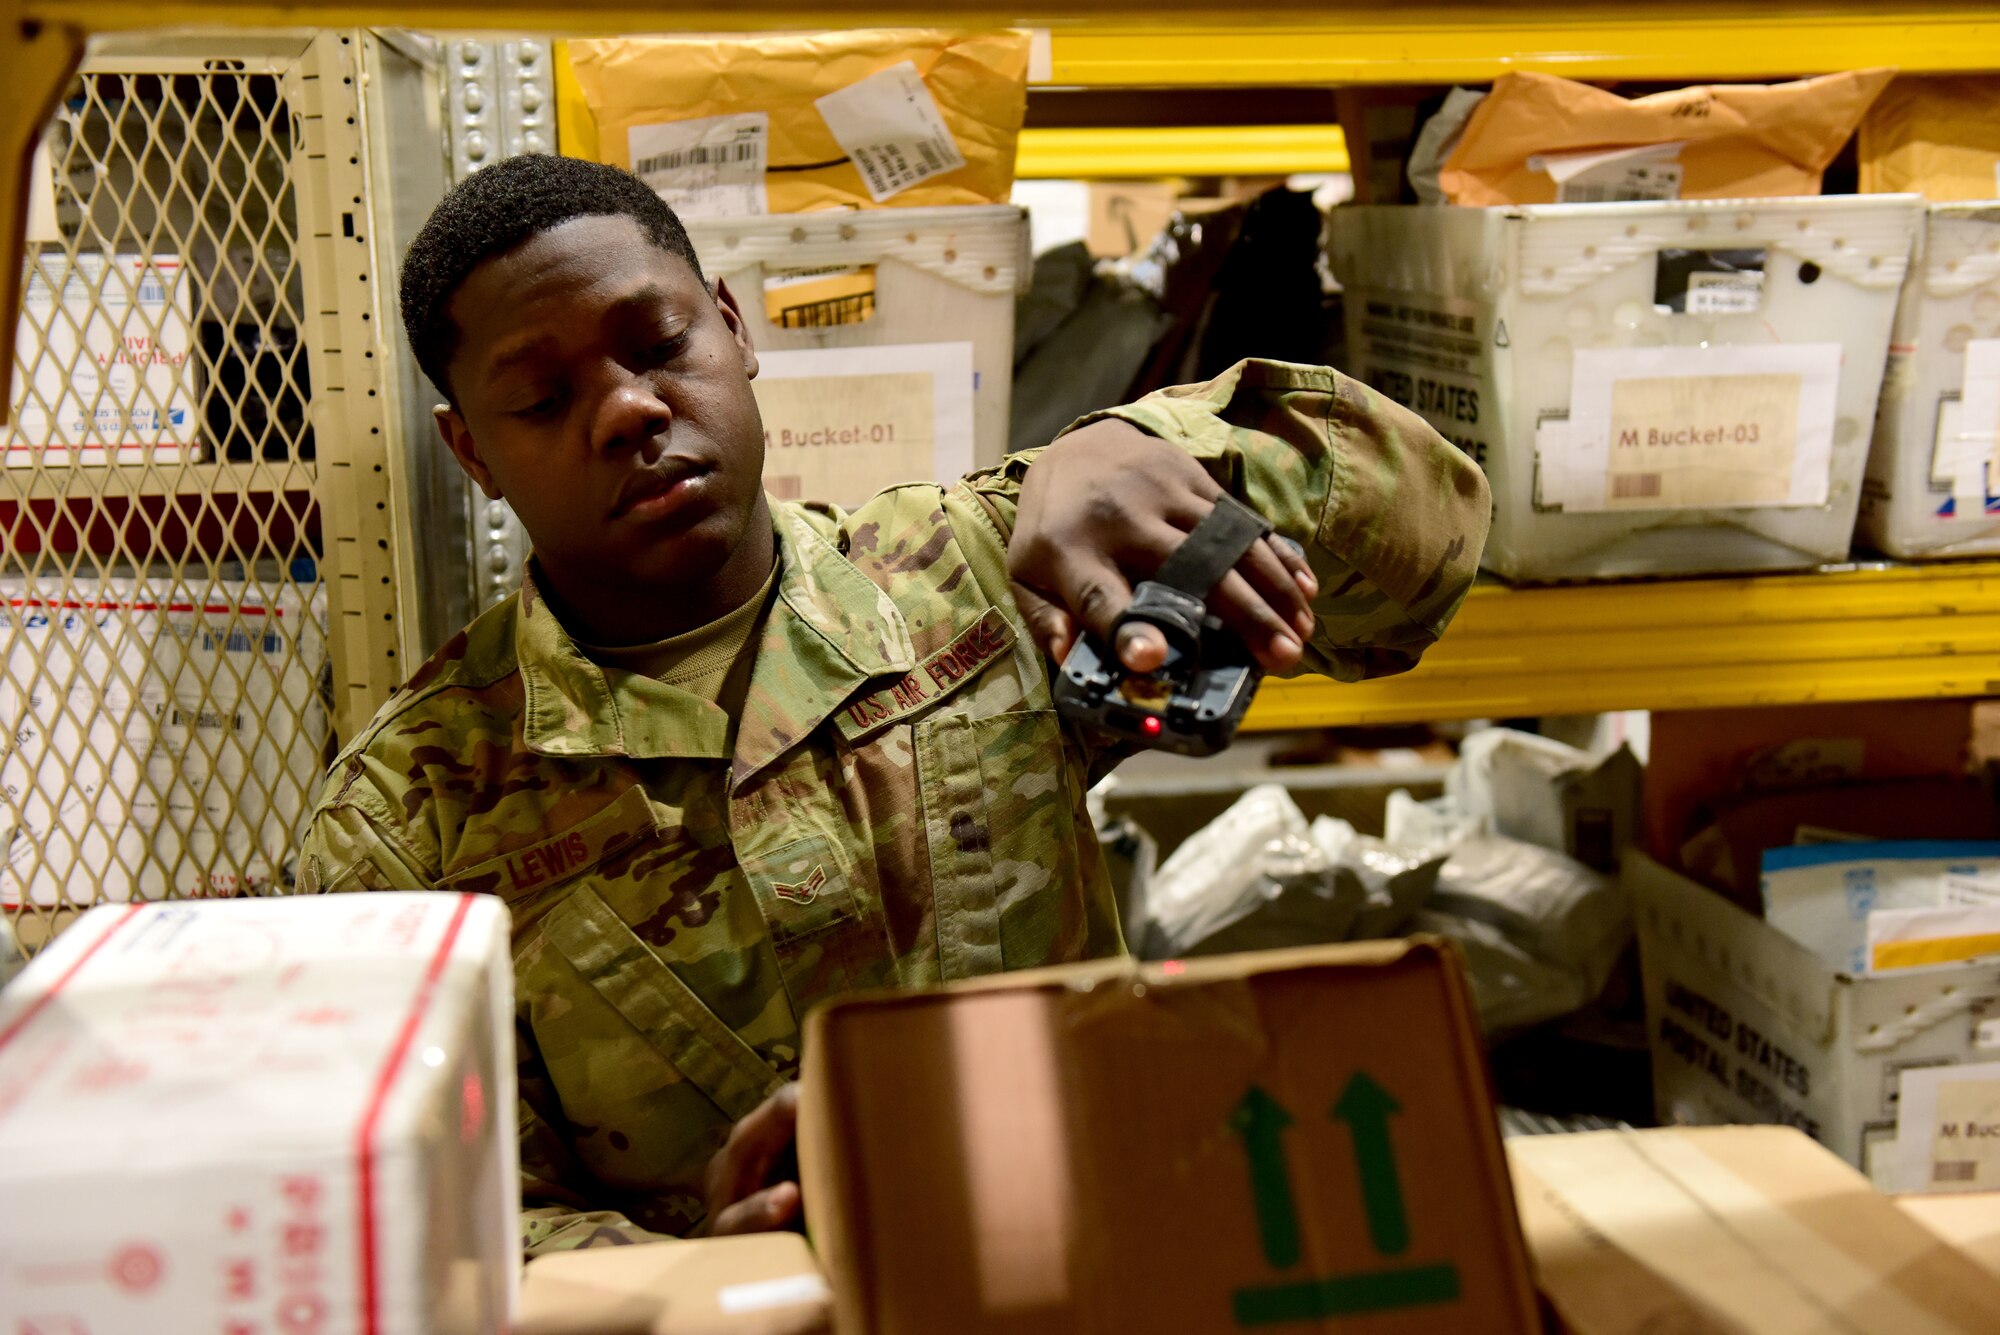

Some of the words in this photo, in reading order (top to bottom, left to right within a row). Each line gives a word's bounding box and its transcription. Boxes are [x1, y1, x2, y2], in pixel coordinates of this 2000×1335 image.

[1417, 377, 1480, 424] STATES
[72, 423, 107, 431] STES
[110, 423, 149, 431] UNED
[780, 423, 895, 448] Bucket-01
[1619, 429, 1639, 447] M
[1647, 423, 1760, 446] Bucket-03
[847, 692, 895, 729] U.S.
[890, 674, 930, 710] AIR
[924, 620, 1006, 690] FORCE
[506, 832, 588, 890] LEWIS
[1737, 1022, 1810, 1097] STATES
[1940, 1122, 1958, 1138] M
